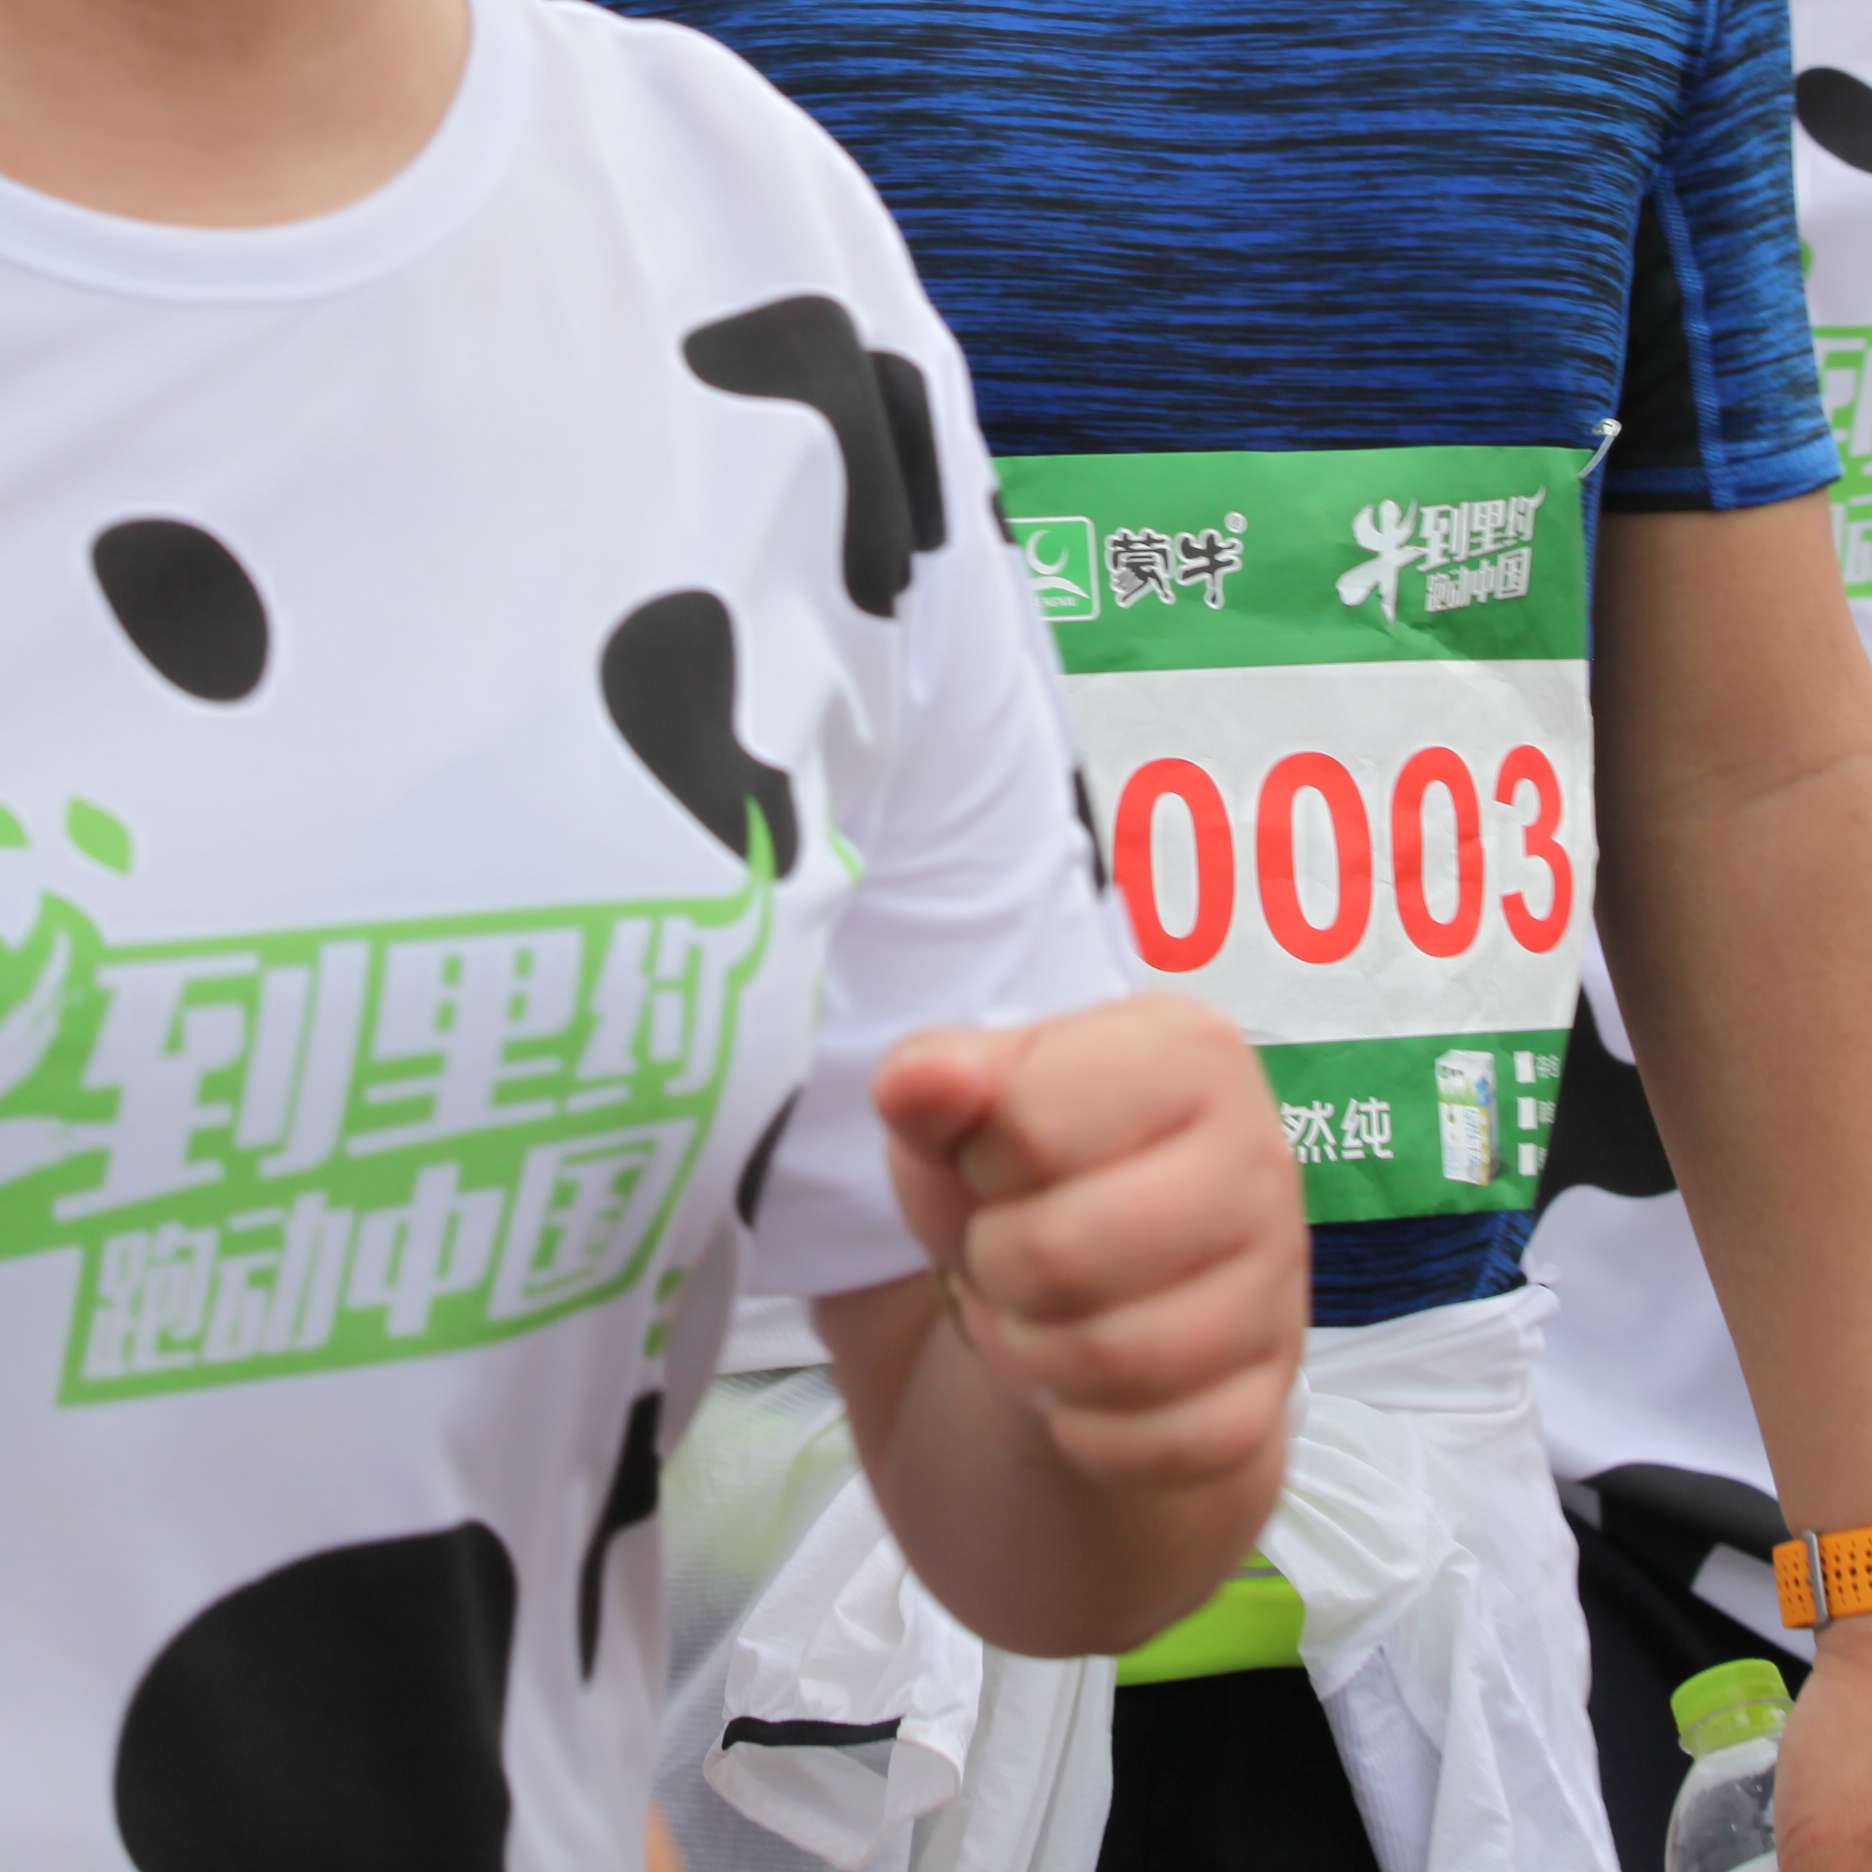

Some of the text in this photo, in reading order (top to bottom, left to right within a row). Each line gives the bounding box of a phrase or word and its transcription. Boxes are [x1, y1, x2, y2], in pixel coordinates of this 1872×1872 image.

[1106, 527, 1244, 609] 蒙牛
[1113, 744, 1573, 973] 0003
[90, 1121, 688, 1376] 跑动中国
